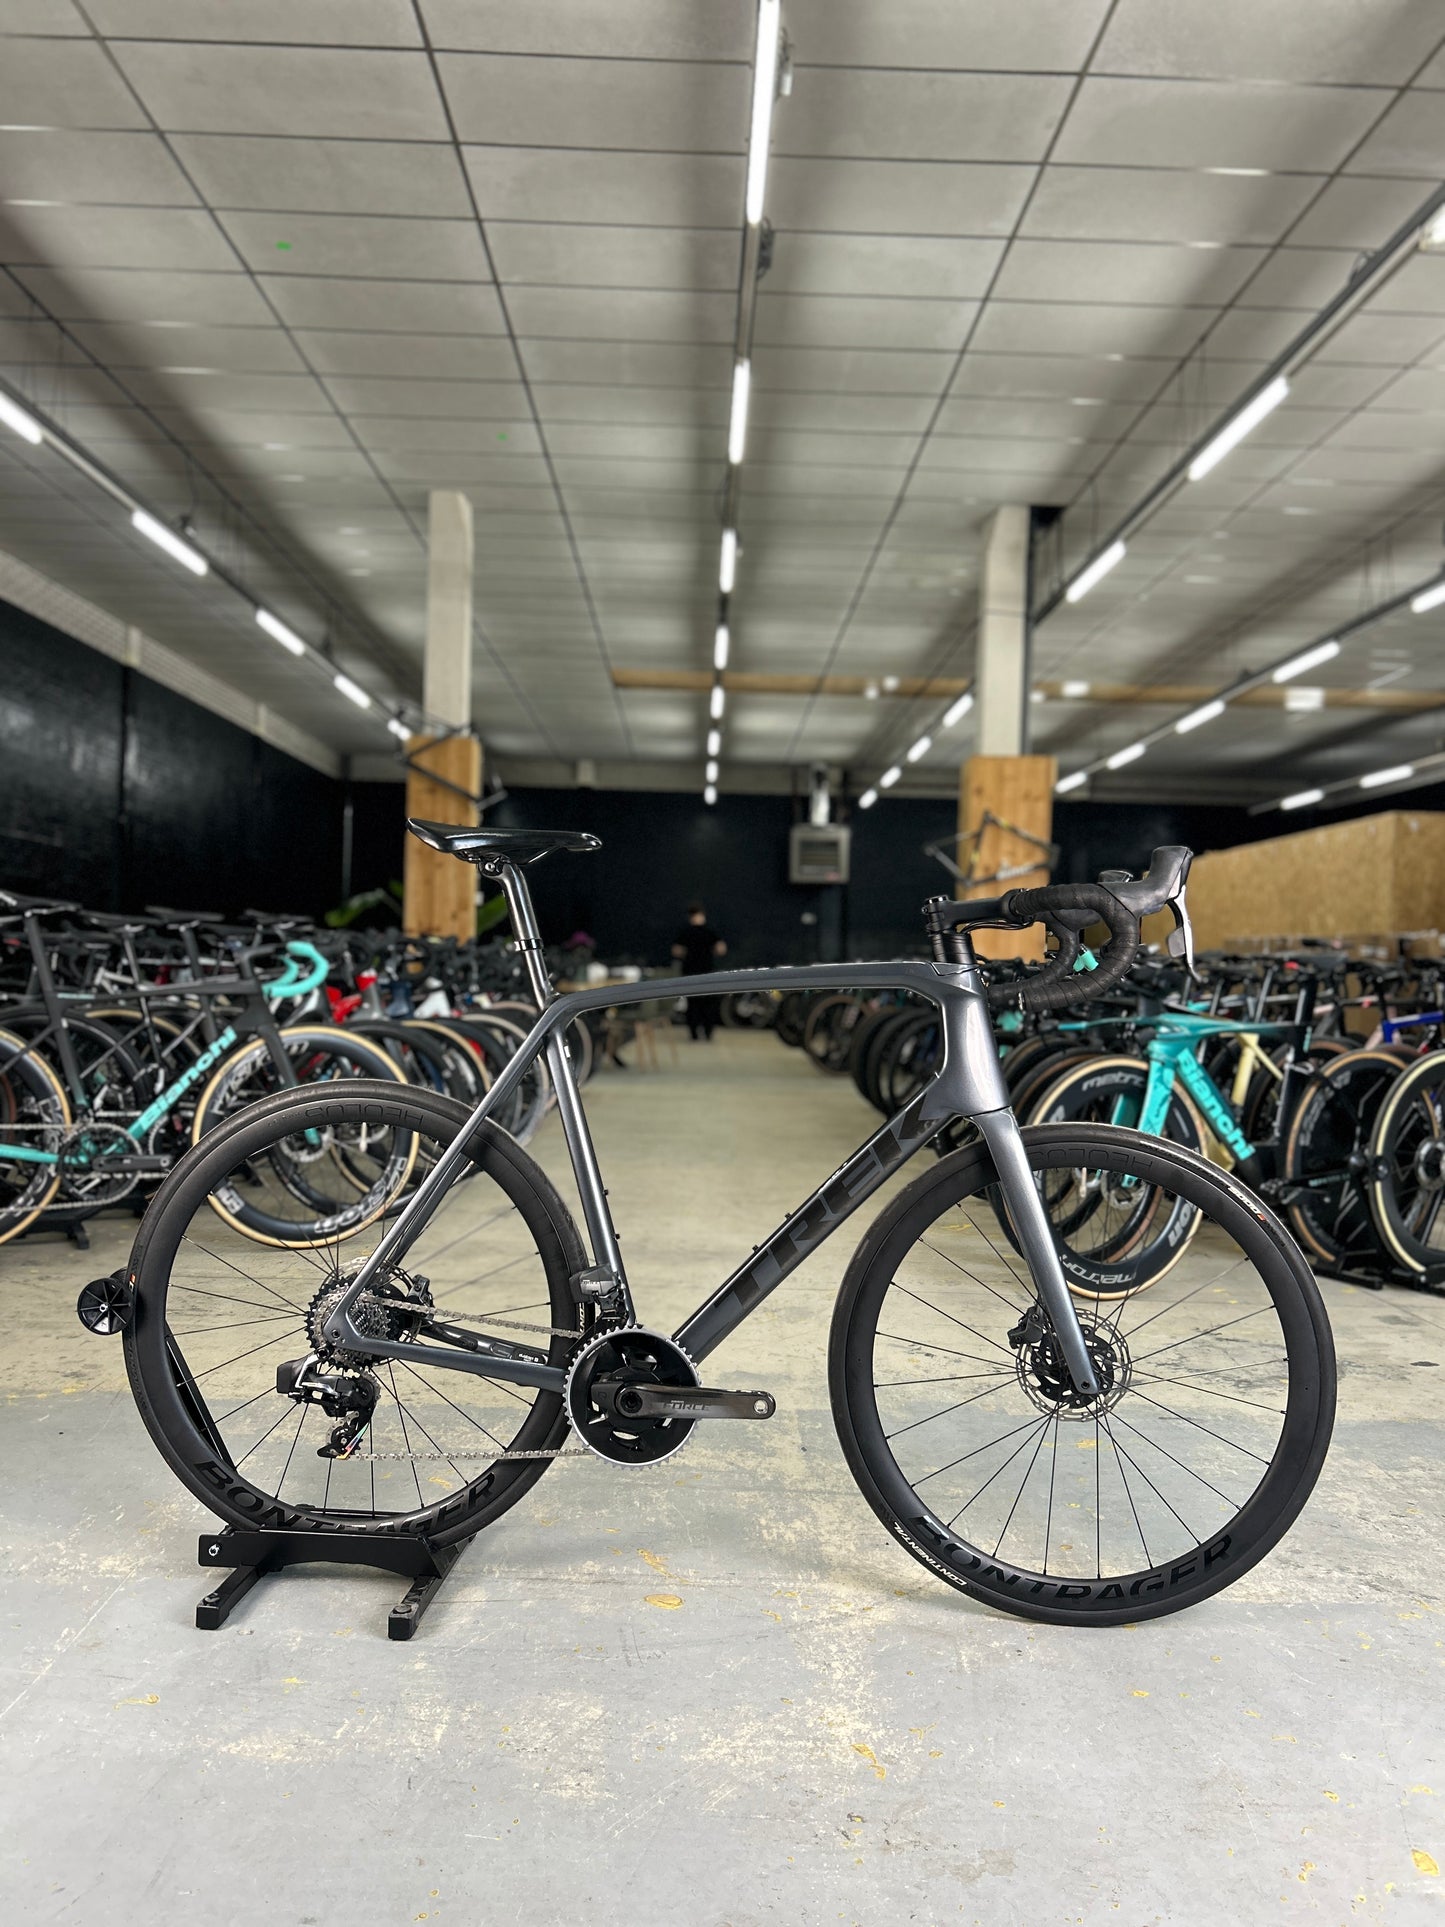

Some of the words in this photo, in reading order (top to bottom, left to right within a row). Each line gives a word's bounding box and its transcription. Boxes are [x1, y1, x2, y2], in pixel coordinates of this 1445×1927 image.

[139, 1024, 238, 1131] Bianchi
[1177, 1048, 1256, 1161] Bianchi
[713, 1092, 942, 1310] TREK
[893, 1521, 968, 1587] CONTINENTAL
[908, 1513, 1233, 1602] BONTRAGER
